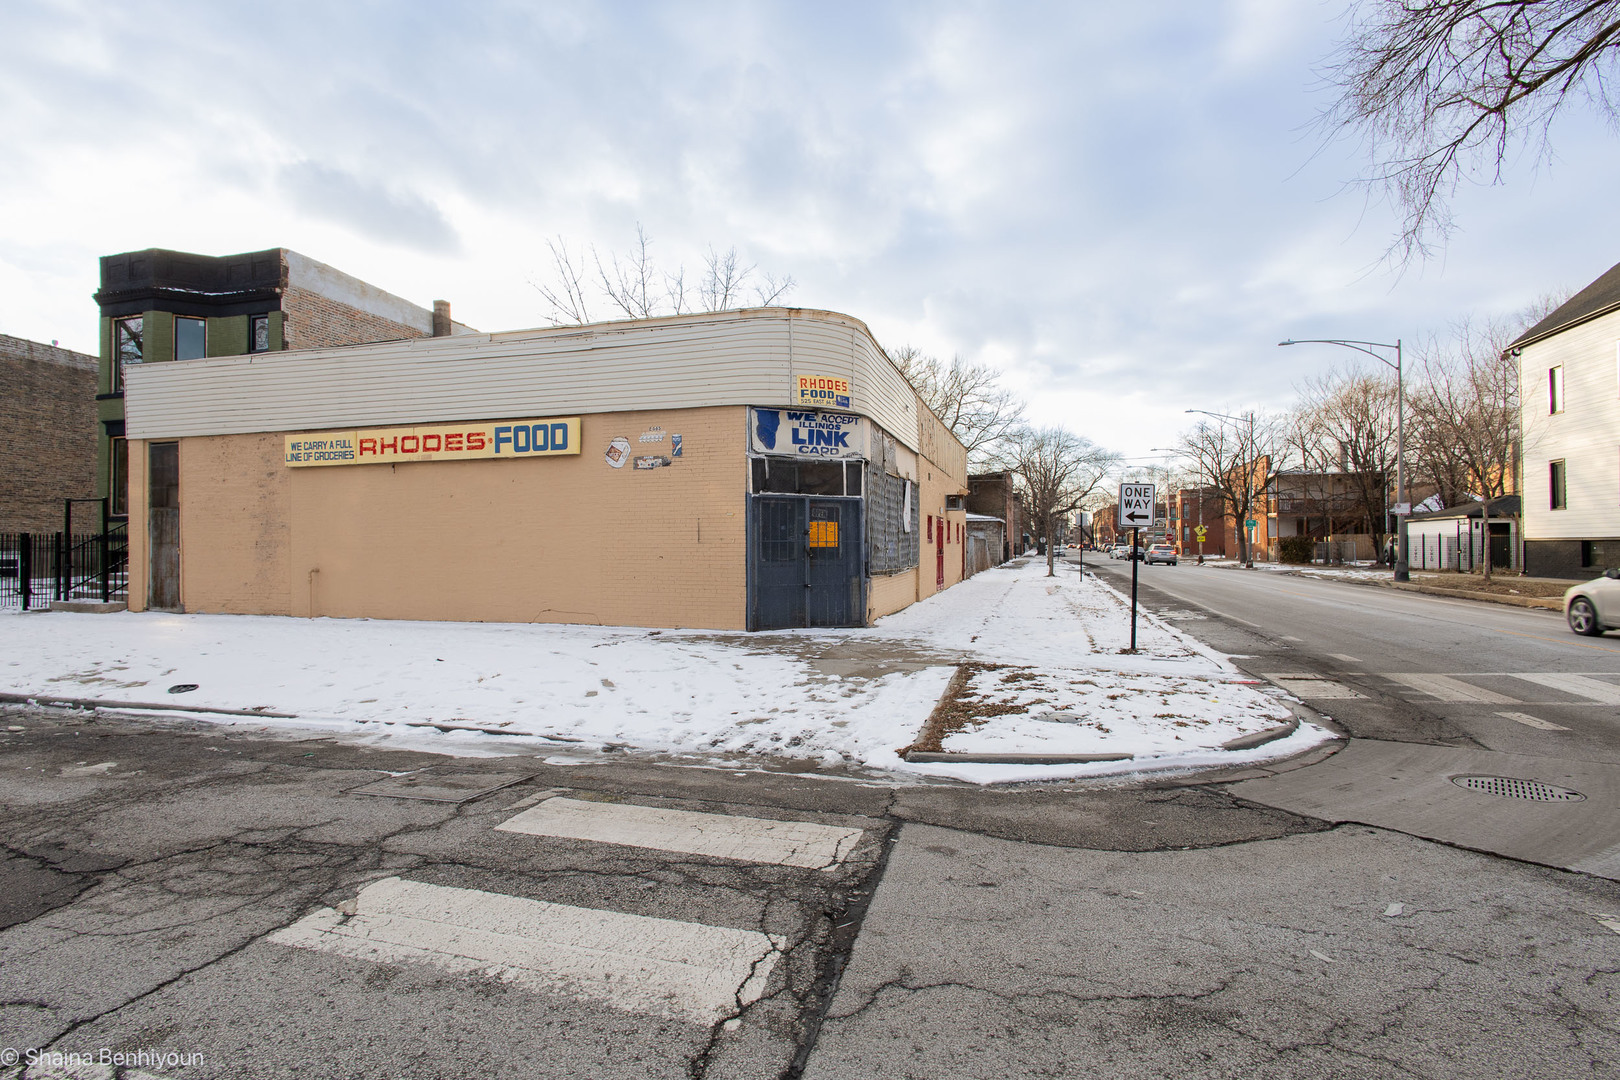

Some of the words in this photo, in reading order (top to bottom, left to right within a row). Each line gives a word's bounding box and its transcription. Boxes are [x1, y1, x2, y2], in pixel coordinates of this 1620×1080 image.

[800, 378, 847, 391] RHODES
[800, 389, 835, 399] FOOD
[786, 411, 817, 421] WE
[821, 414, 860, 426] ACCEPT
[799, 421, 842, 431] ILLINIOS
[359, 432, 486, 456] RHODES
[494, 423, 568, 454] FOOD
[791, 427, 850, 447] LINK
[290, 442, 302, 451] WE
[303, 441, 328, 451] CARRY
[329, 440, 335, 450] A
[335, 439, 353, 449] FULL
[798, 445, 840, 455] CARD
[285, 452, 302, 462] LINE
[303, 451, 313, 462] OF
[314, 450, 355, 461] GROCERIES
[1124, 487, 1150, 498] ONE
[1124, 498, 1151, 509] WAY
